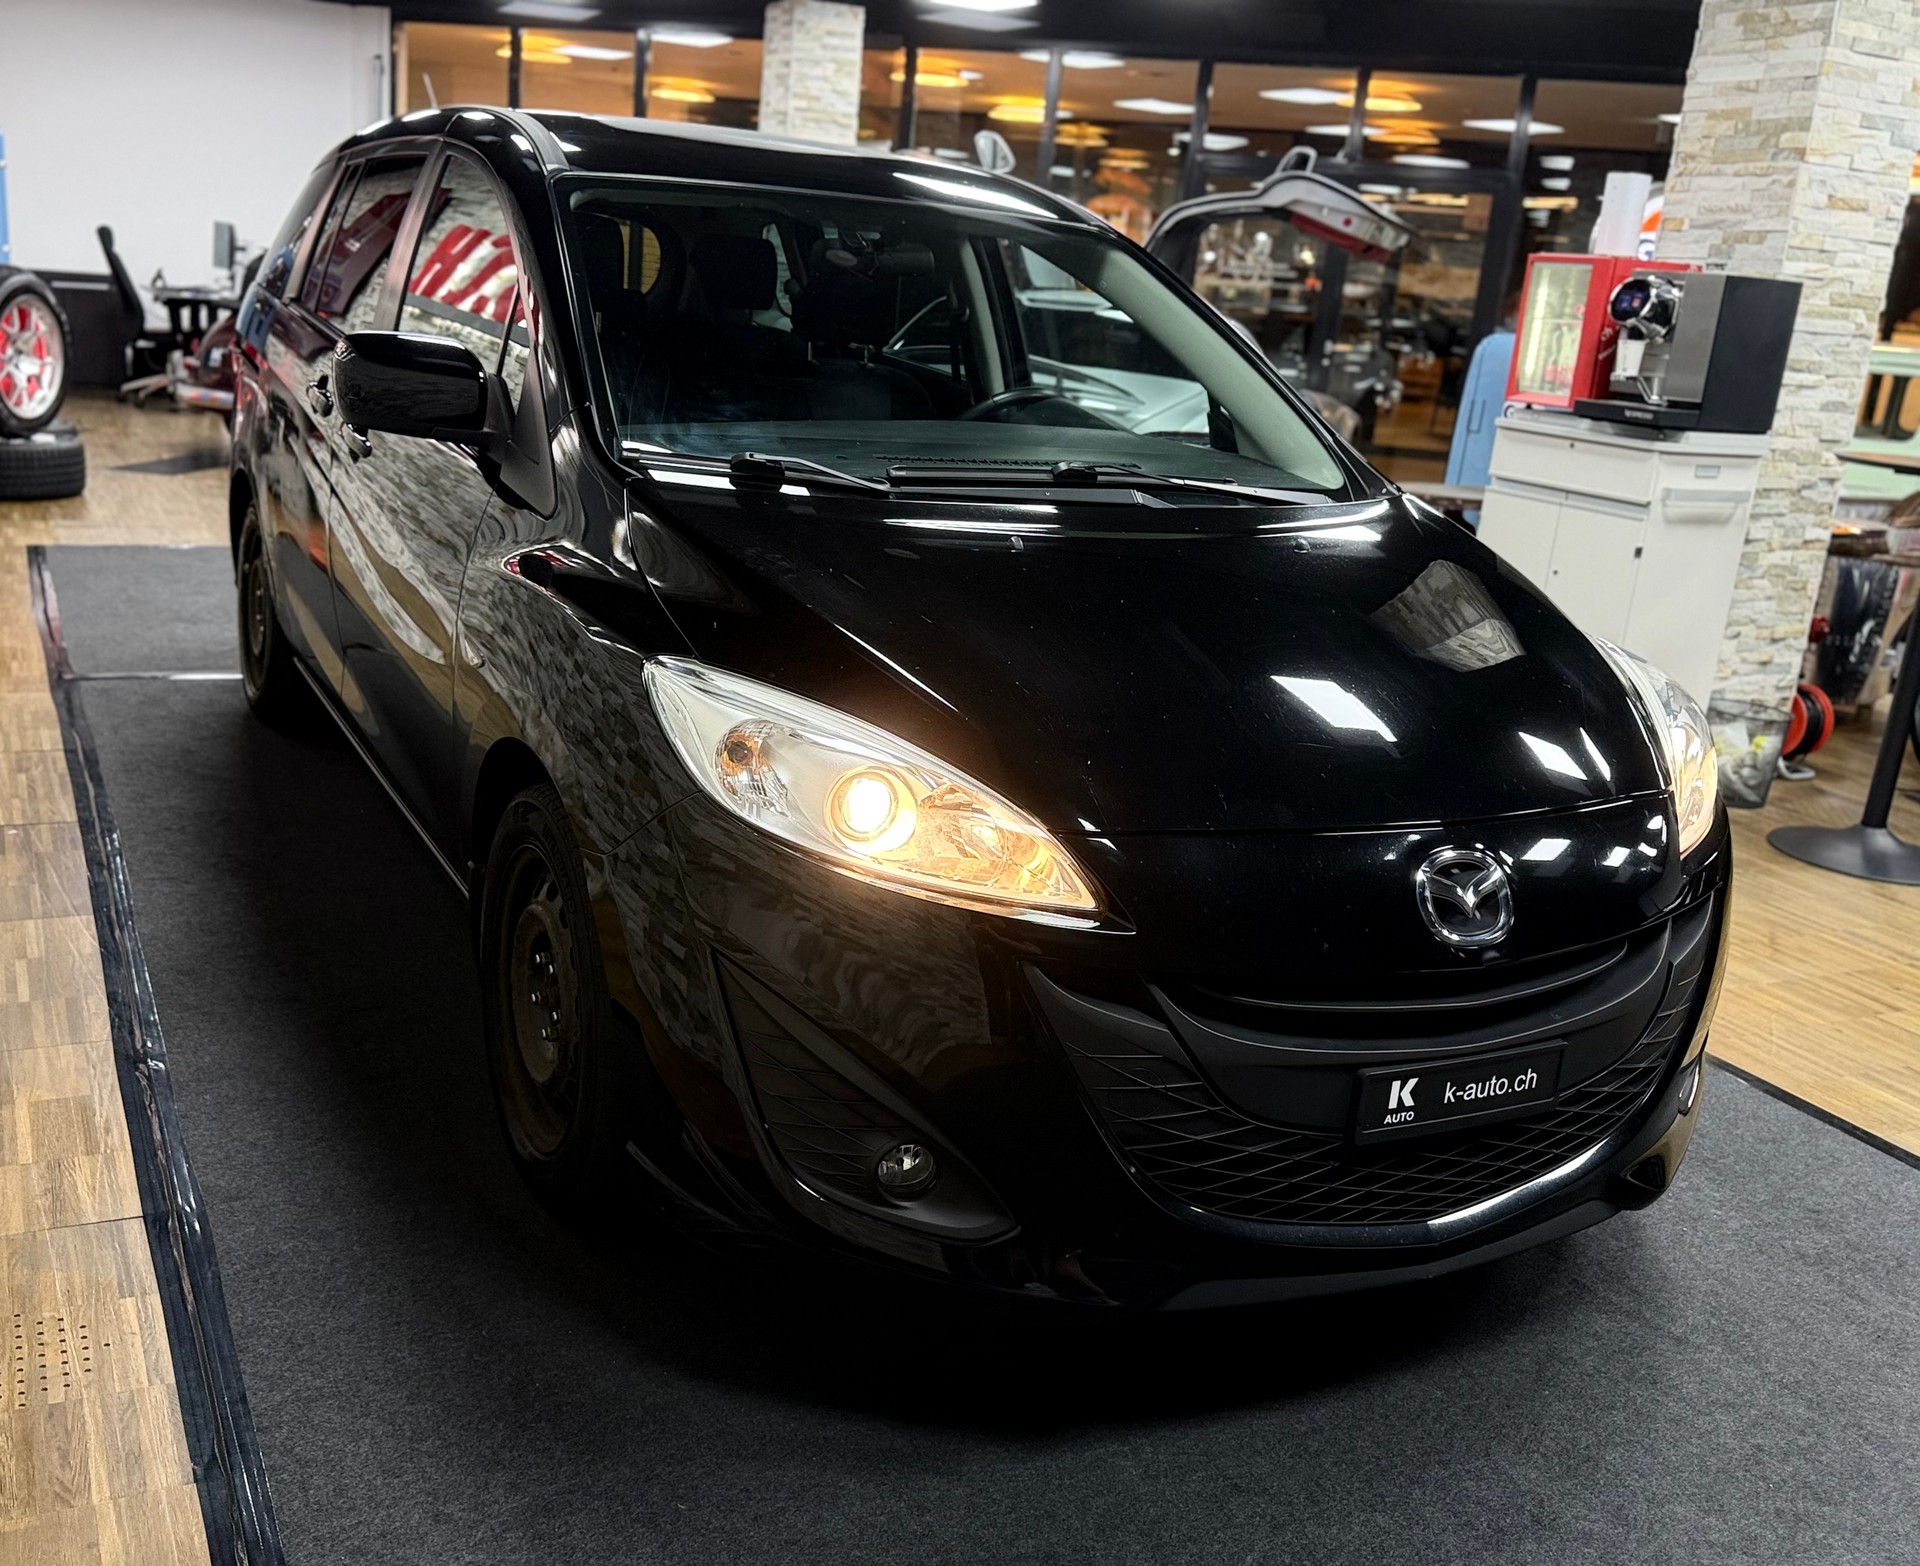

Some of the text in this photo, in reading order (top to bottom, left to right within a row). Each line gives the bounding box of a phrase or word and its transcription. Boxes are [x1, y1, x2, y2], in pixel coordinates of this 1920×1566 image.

[1388, 1077, 1419, 1109] K
[1443, 1068, 1538, 1104] k-auto.ch
[1383, 1111, 1415, 1124] AUTO
